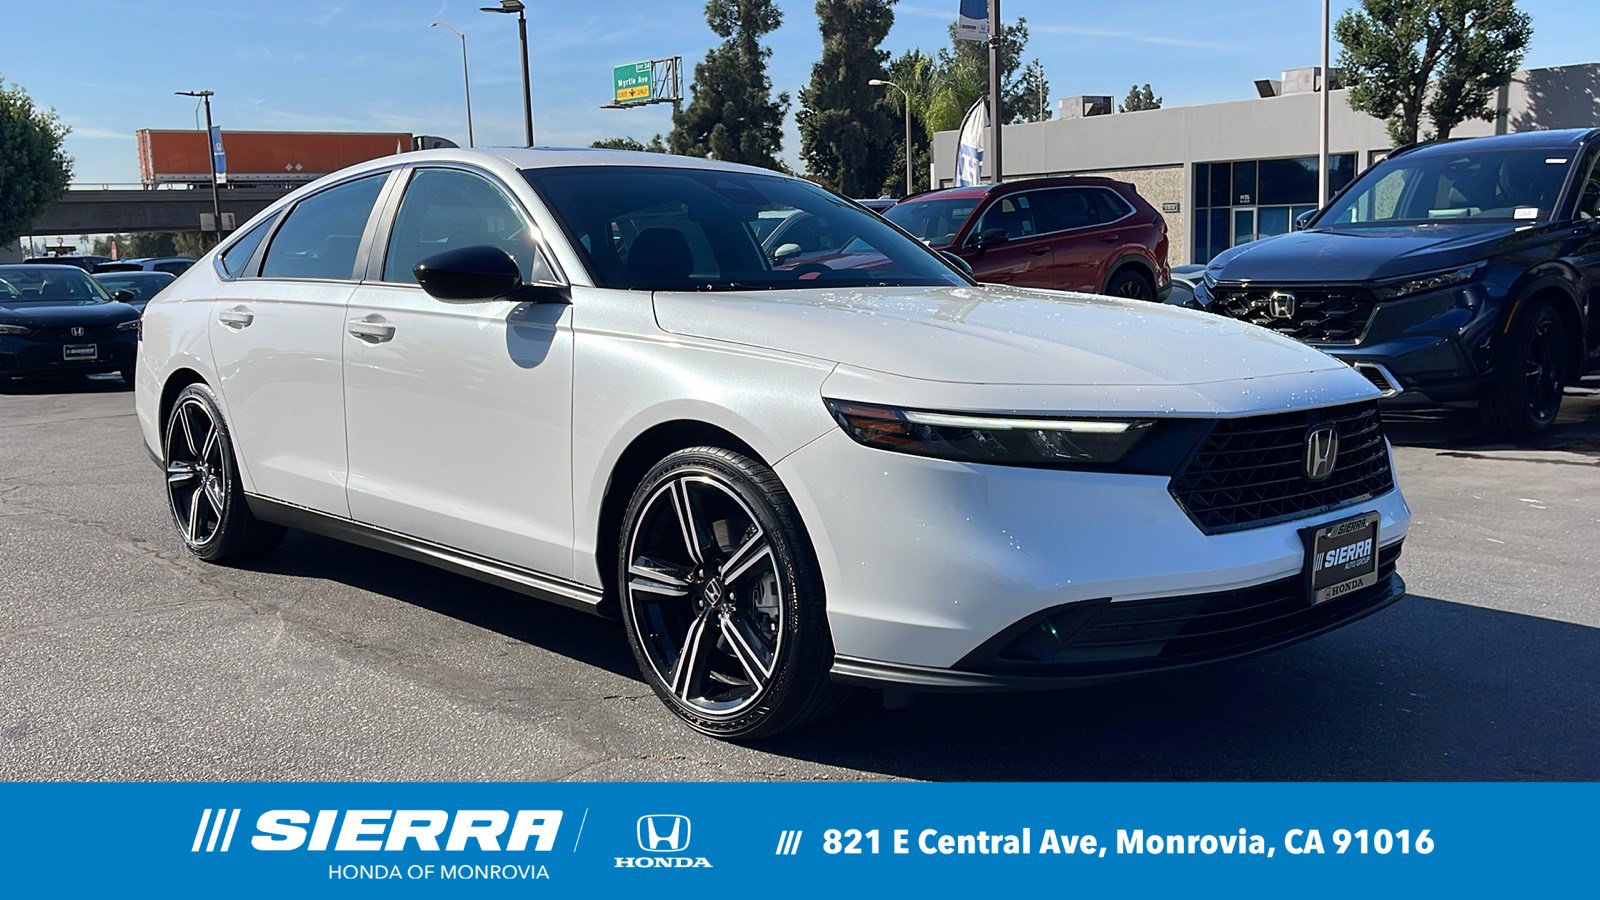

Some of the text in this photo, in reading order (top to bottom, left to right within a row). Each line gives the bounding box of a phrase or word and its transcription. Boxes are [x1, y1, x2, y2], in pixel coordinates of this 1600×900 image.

[617, 75, 649, 88] Myrtle Ave
[1337, 516, 1368, 535] SIERRA
[1324, 538, 1373, 568] SIERRA
[1344, 555, 1371, 570] AUTO GROUP
[1332, 578, 1364, 596] HONDA
